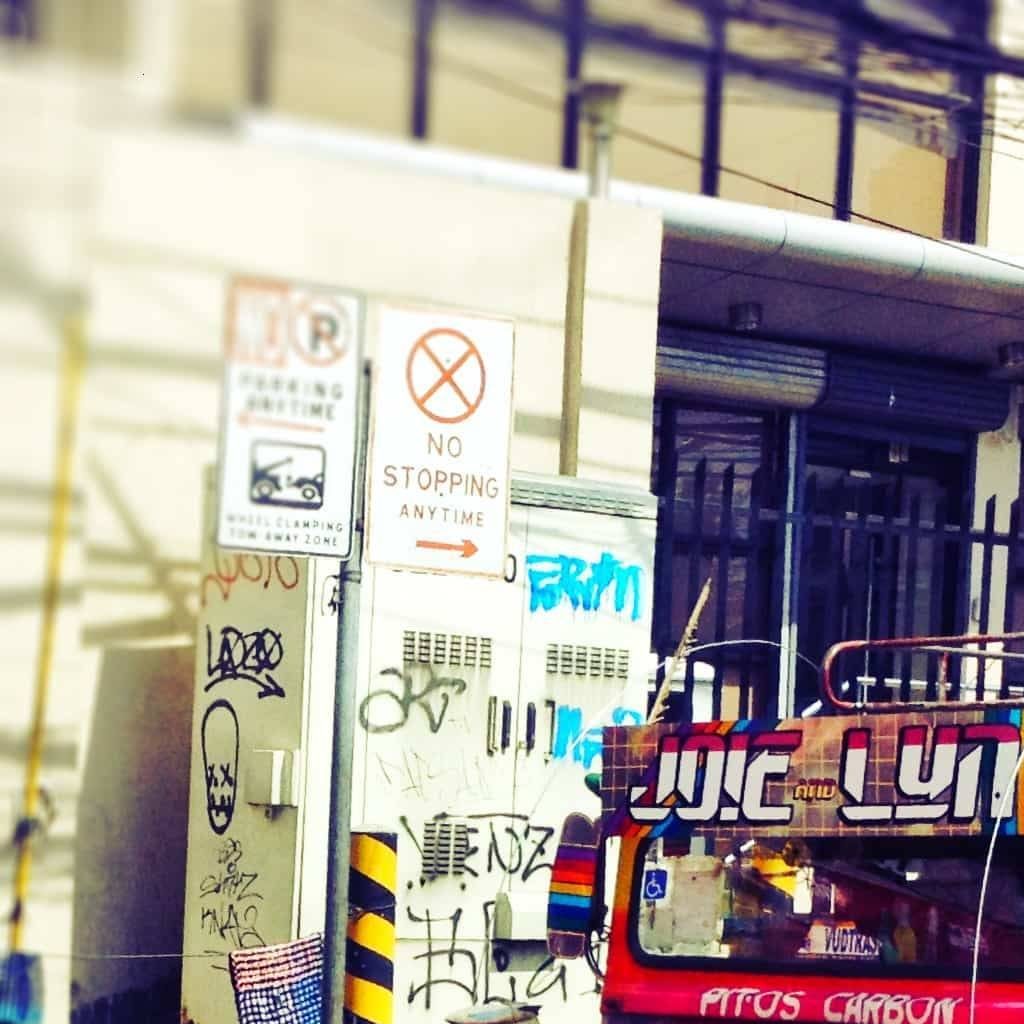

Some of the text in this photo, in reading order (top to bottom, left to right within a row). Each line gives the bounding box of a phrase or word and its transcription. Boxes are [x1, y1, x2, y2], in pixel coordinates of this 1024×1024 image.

[427, 432, 462, 458] NO
[383, 464, 499, 499] STOPPING
[275, 516, 343, 533] CLAMPING
[399, 503, 484, 527] ANYTIME
[304, 534, 338, 546] ZONE
[700, 987, 806, 1021] PITOS
